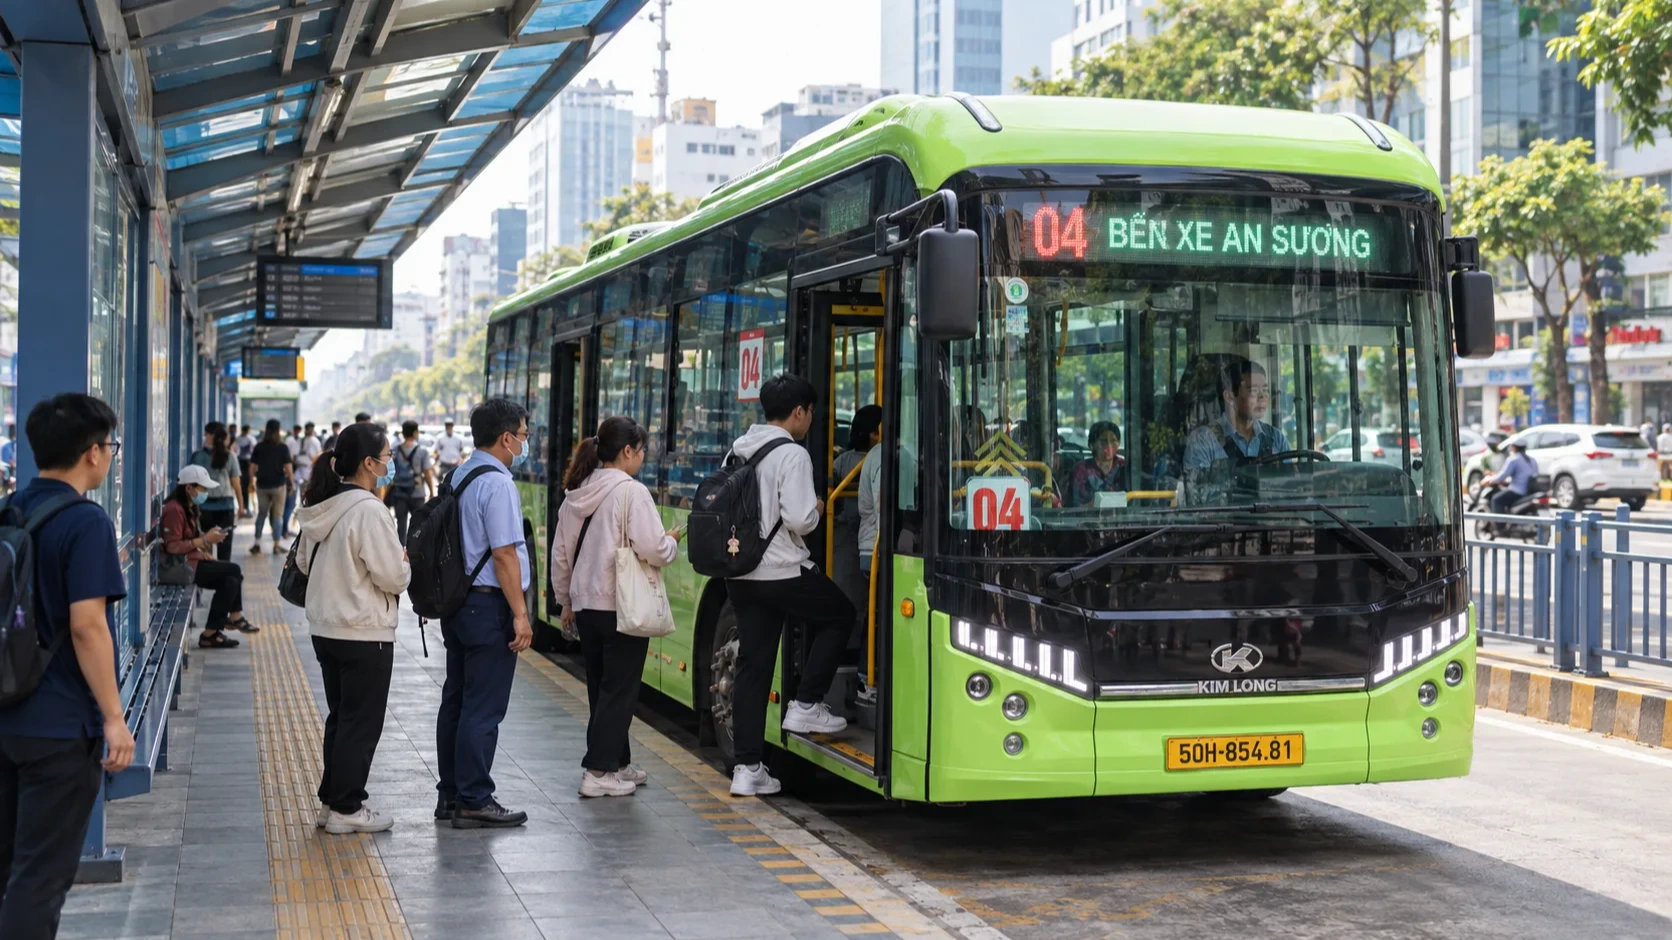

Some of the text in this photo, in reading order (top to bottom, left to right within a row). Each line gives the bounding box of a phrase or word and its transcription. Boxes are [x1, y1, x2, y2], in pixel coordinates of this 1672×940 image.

[1034, 206, 1088, 258] 04
[1109, 212, 1169, 249] BẾN
[1176, 220, 1213, 251] XE
[1222, 222, 1262, 253] AN
[741, 346, 760, 390] 04
[973, 487, 1025, 530] 04
[1198, 679, 1277, 694] KIM LONG
[1179, 739, 1291, 764] 50H-854.81
